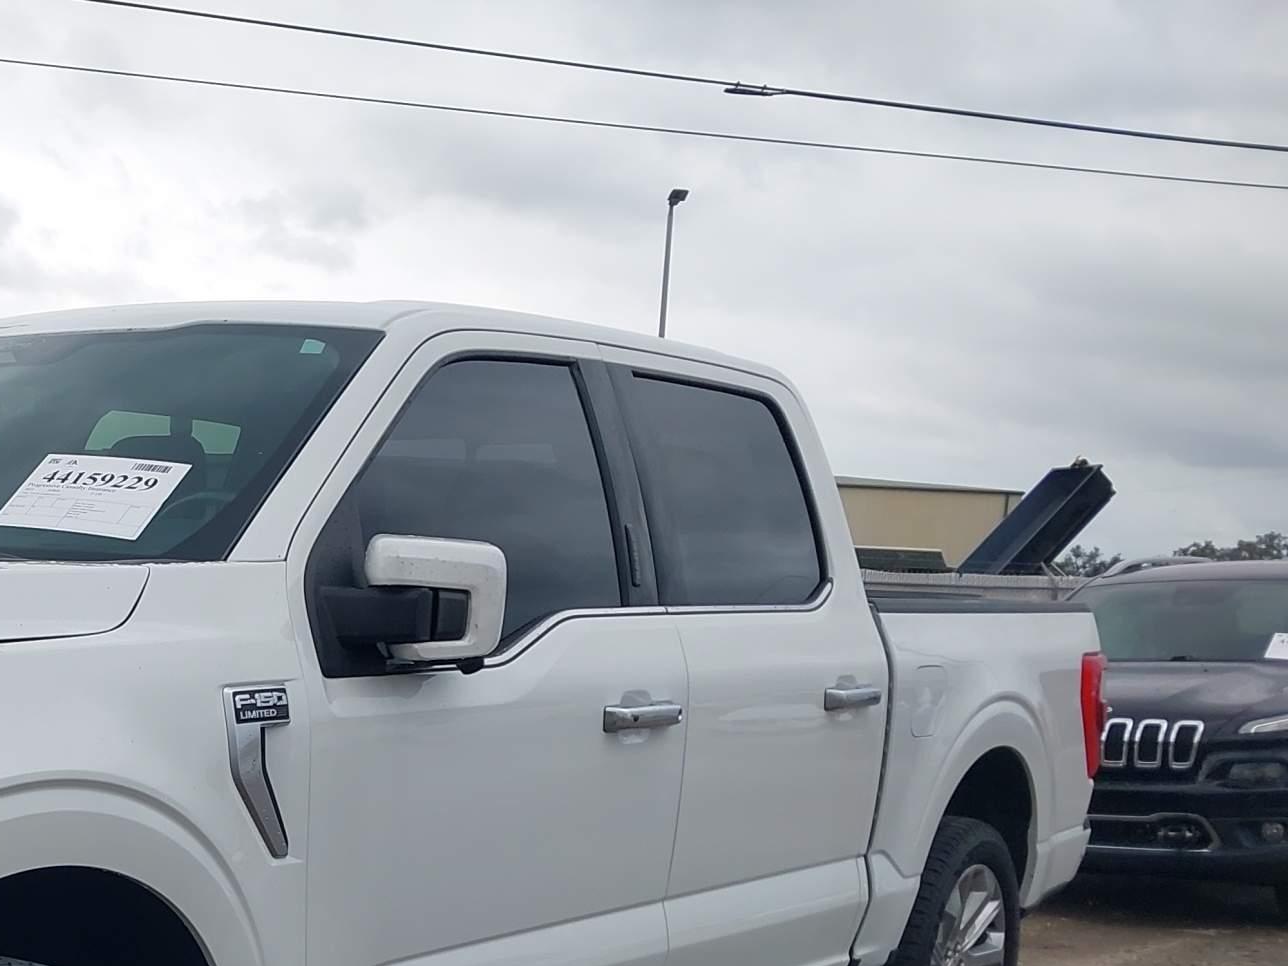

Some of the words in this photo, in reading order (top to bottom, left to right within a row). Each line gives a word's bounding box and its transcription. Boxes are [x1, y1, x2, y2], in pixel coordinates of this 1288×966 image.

[43, 470, 159, 492] 44159229
[235, 692, 288, 709] F-150
[240, 709, 278, 720] LIMITED
